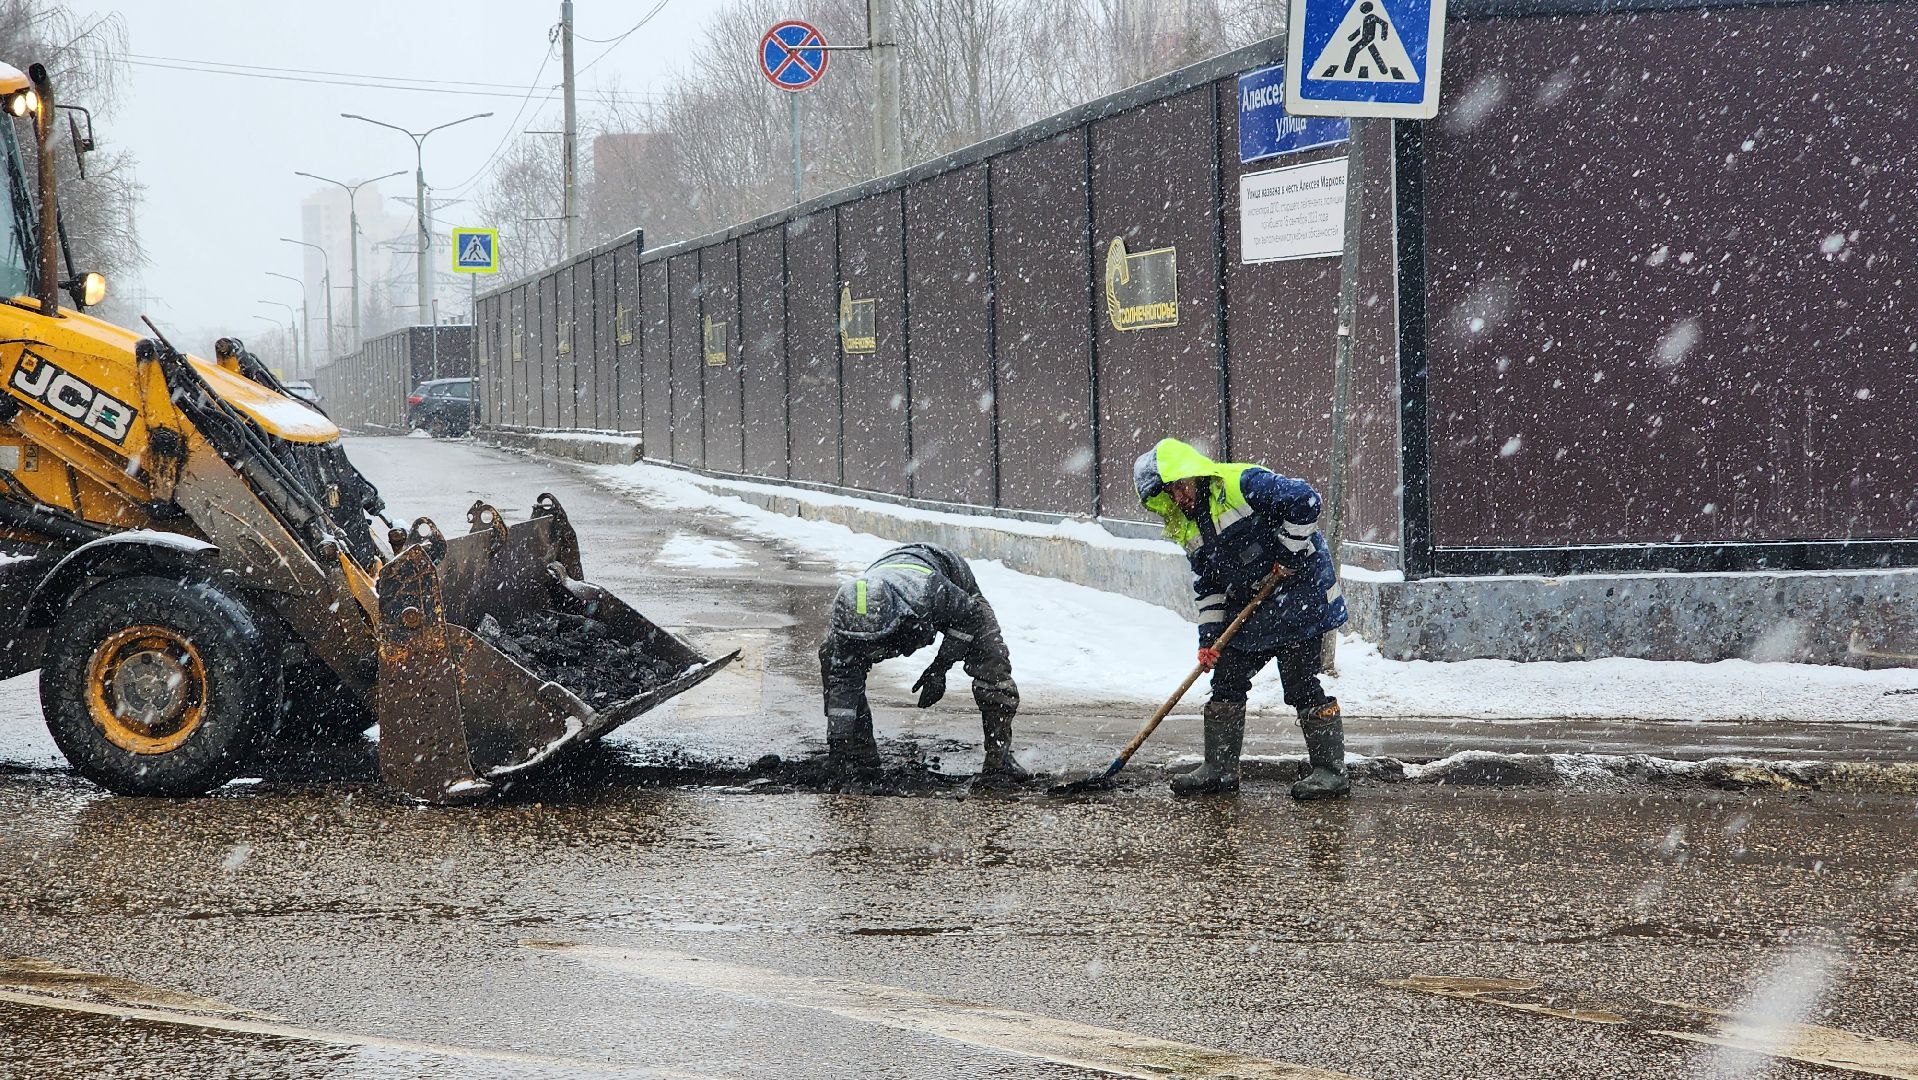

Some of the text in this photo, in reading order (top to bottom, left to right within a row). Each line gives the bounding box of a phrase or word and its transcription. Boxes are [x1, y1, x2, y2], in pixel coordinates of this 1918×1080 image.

[1275, 116, 1307, 142] улица
[1247, 187, 1261, 199] Улица
[1261, 185, 1281, 198] названа
[1285, 182, 1299, 194] честь
[1299, 178, 1320, 192] Алексея
[1320, 175, 1344, 190] Маркова
[14, 363, 131, 440] JCB
